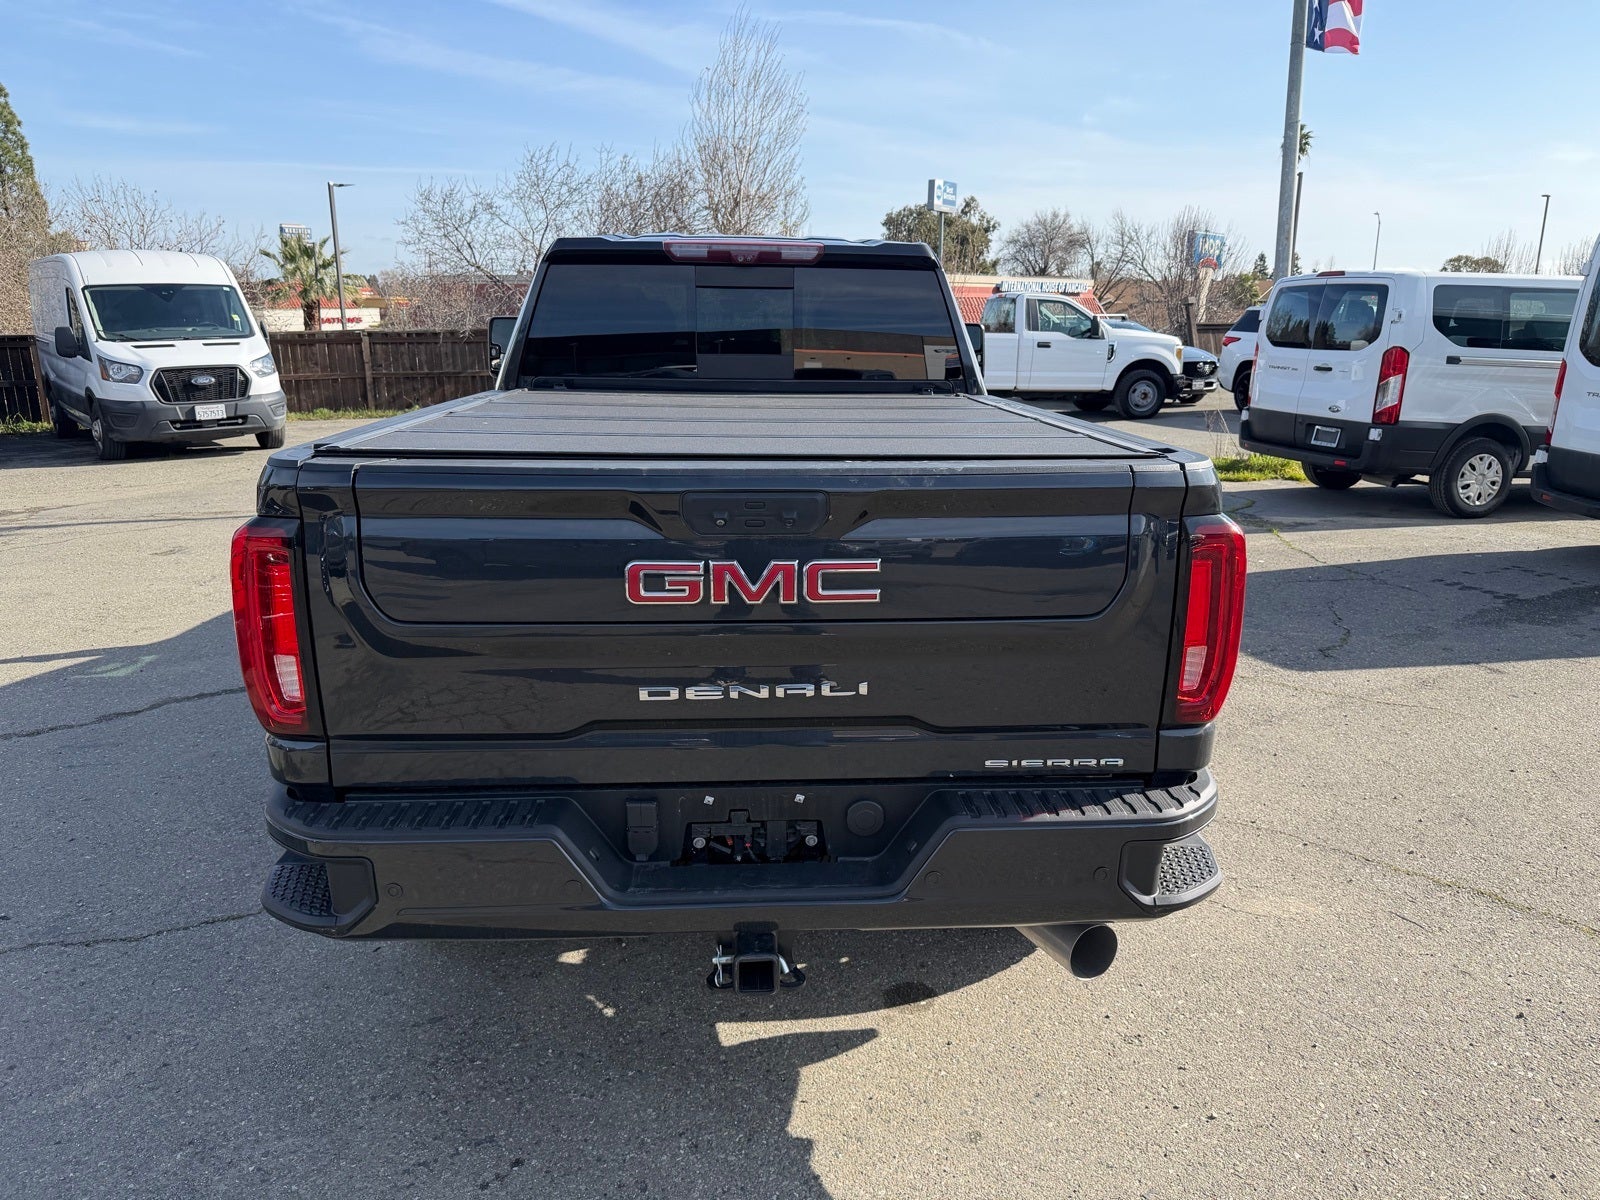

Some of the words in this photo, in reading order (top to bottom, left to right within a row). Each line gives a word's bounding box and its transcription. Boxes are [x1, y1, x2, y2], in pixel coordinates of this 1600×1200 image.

[1001, 281, 1041, 293] INTERNATIONAL
[1042, 282, 1059, 293] HOUSE
[624, 558, 882, 605] GMC
[638, 681, 869, 701] DENALI
[984, 757, 1125, 768] SIERRA
